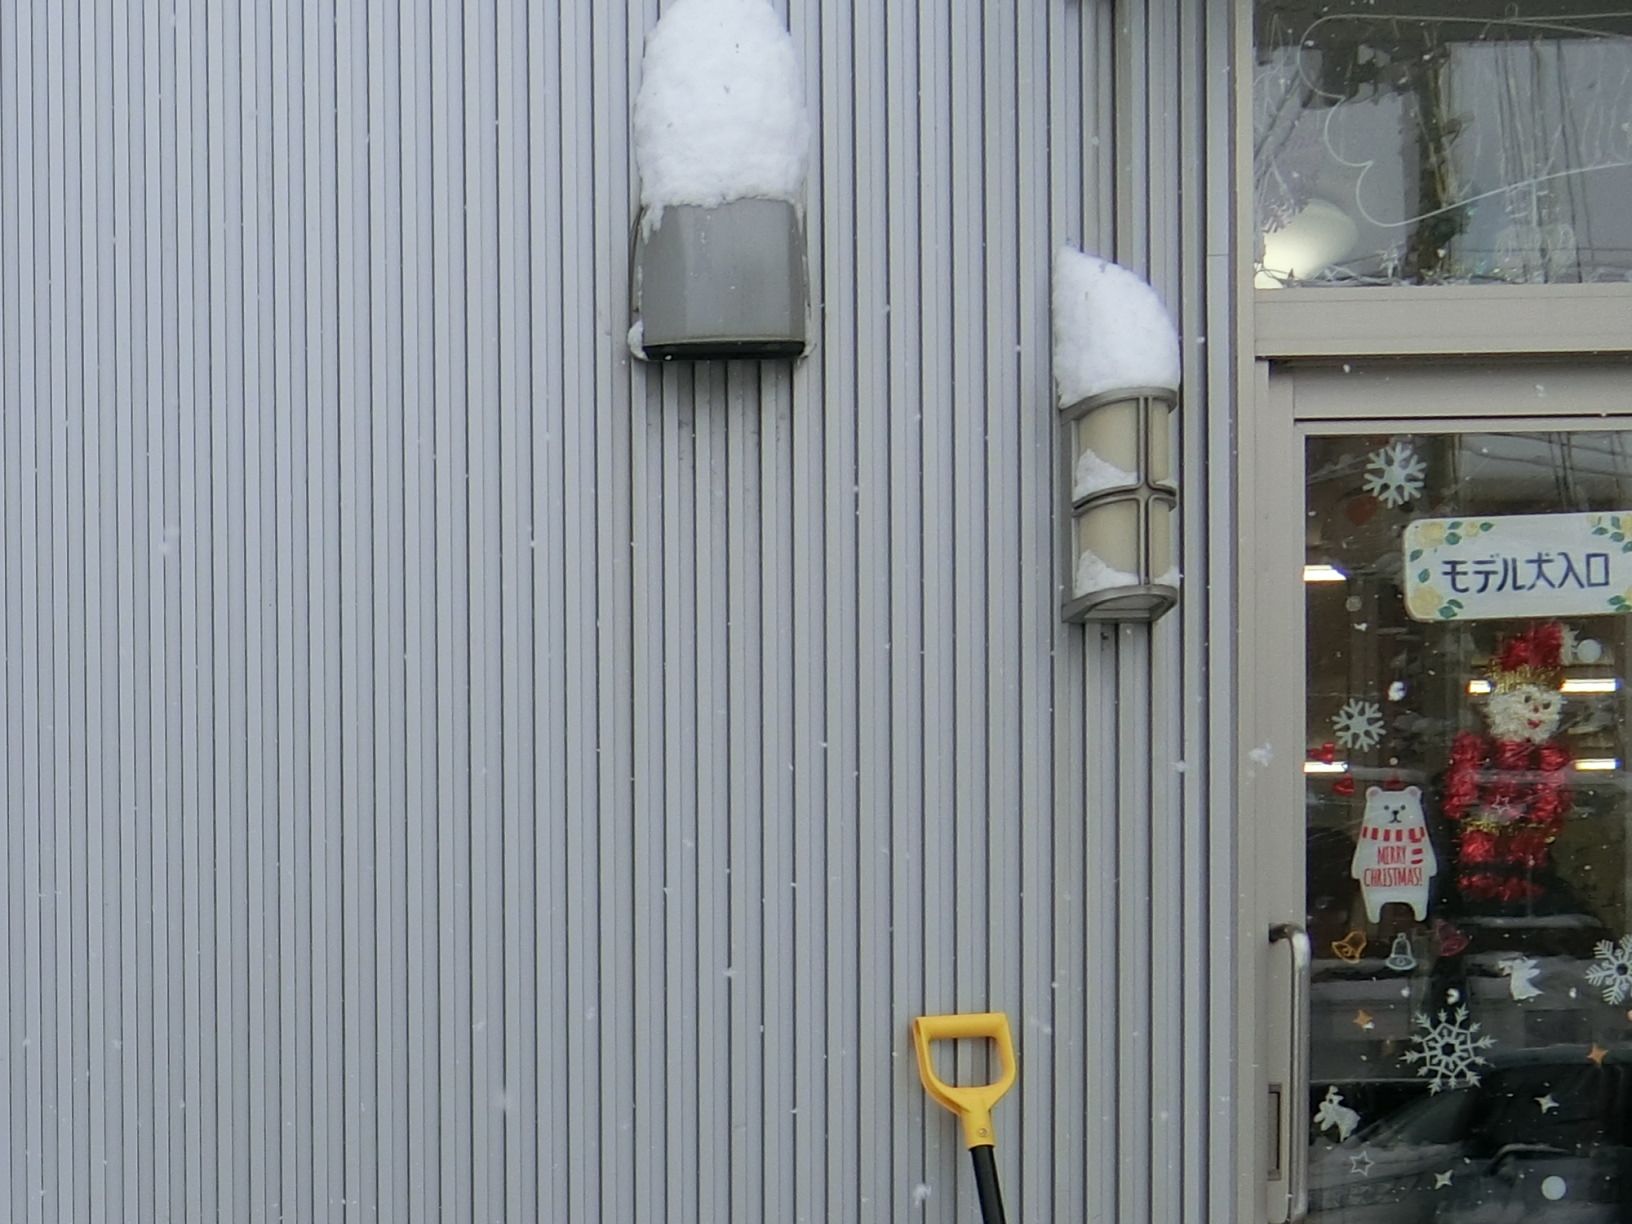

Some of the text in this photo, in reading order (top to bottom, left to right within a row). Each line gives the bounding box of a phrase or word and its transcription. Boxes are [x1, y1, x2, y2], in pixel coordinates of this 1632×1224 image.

[1441, 551, 1611, 594] モデル犬入口
[1377, 845, 1407, 865] MERRY
[1363, 867, 1424, 888] CHRISTMAS!
